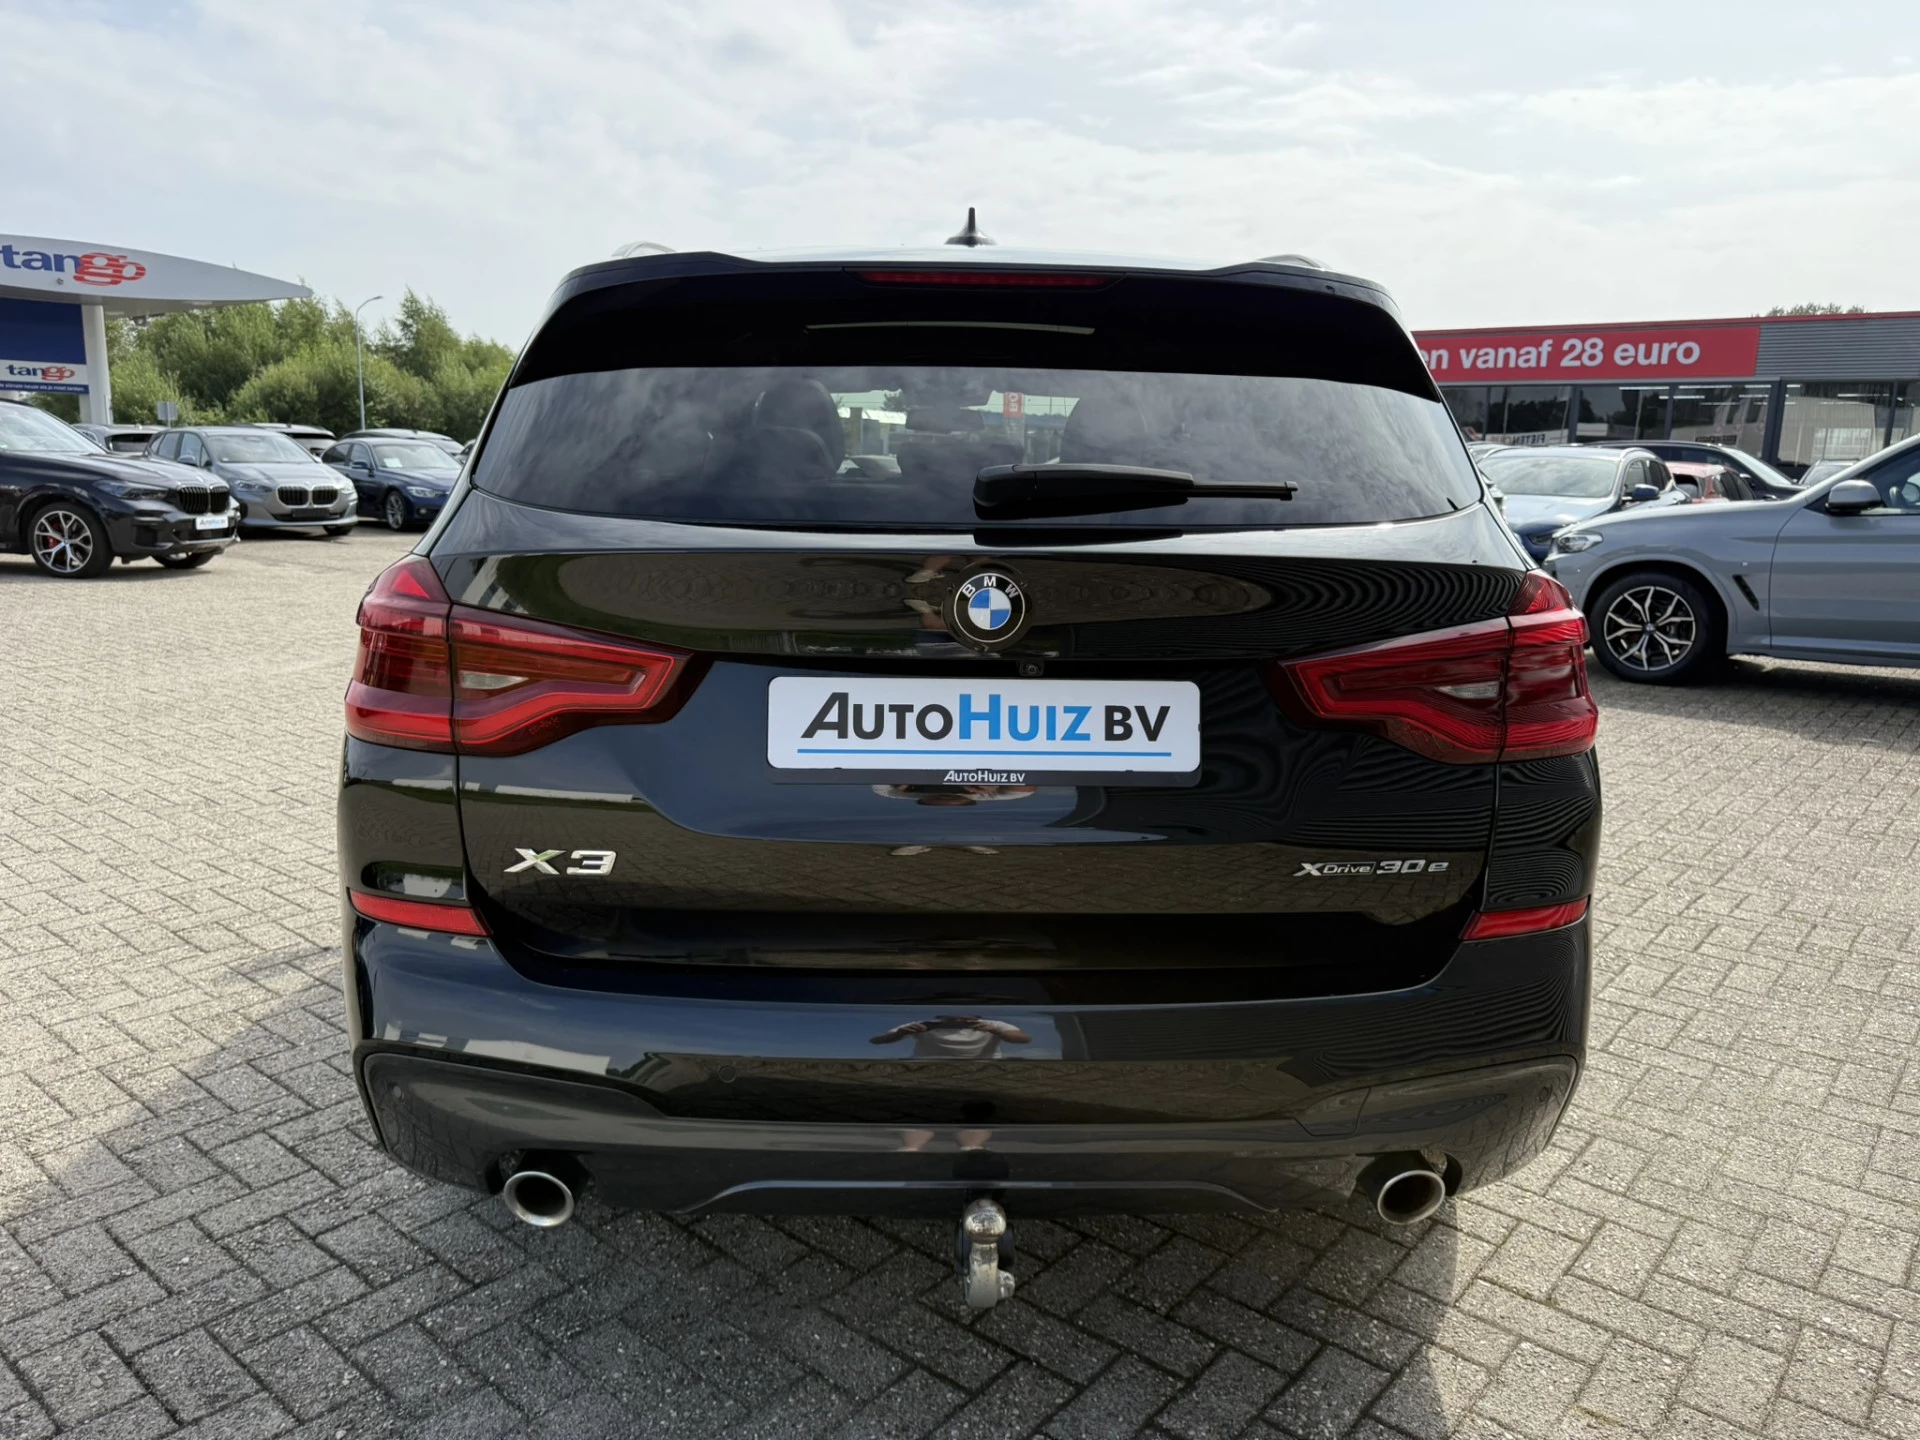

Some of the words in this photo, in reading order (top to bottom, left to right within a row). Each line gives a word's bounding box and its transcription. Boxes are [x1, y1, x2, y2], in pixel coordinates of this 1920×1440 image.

[0, 244, 146, 286] tango
[1459, 339, 1553, 370] vanaf
[1560, 337, 1604, 368] 28
[1613, 340, 1701, 367] euro
[5, 364, 75, 381] tango
[962, 576, 1019, 598] BMW
[1104, 705, 1171, 742] BV
[1009, 773, 1026, 783] BV
[503, 848, 617, 875] X3
